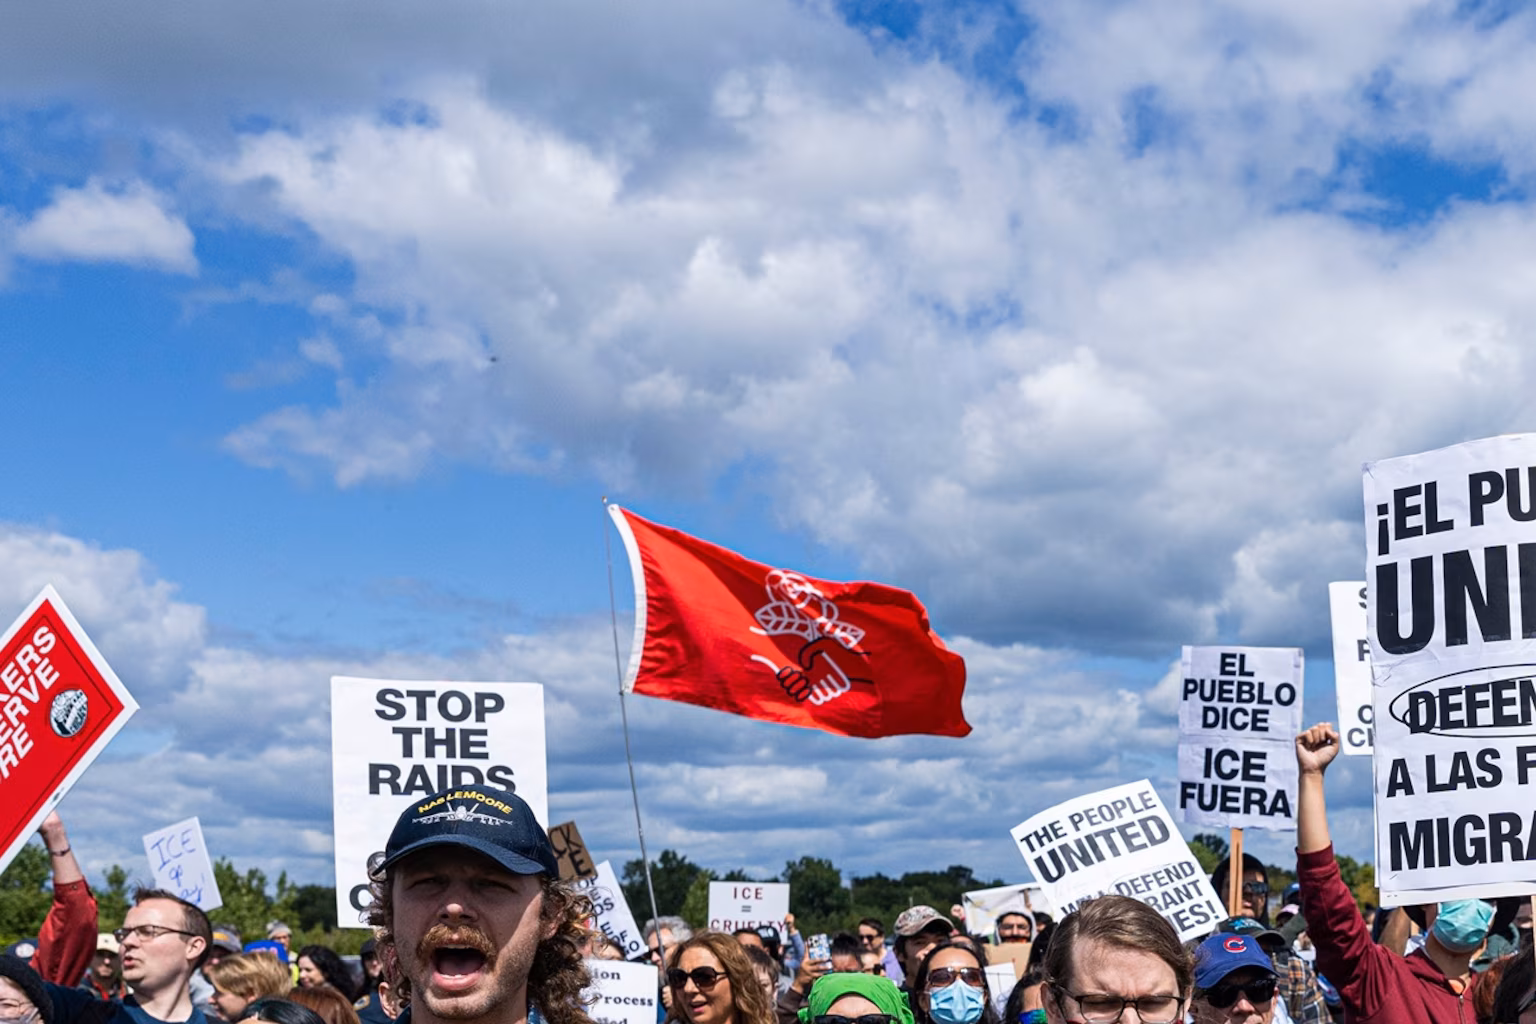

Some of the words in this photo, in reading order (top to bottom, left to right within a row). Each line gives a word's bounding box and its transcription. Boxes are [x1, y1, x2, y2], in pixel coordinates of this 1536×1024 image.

[1376, 481, 1454, 556] ¡EL
[1219, 652, 1255, 677] EL
[375, 688, 505, 723] STOP
[1183, 678, 1296, 706] PUEBLO
[1202, 706, 1270, 732] DICE
[392, 726, 489, 760] THE
[368, 763, 516, 796] RAIDS
[1203, 748, 1267, 783] ICE
[1386, 757, 1415, 798] A
[1426, 747, 1503, 793] LAS
[418, 797, 445, 814] NAS
[447, 791, 513, 814] LEMOORE
[1180, 781, 1292, 818] FUERA
[1020, 820, 1067, 853] THE
[1068, 790, 1156, 832] PEOPLE
[151, 829, 196, 871] ICE
[1034, 815, 1170, 884] UNITED
[733, 887, 763, 900] ICE
[1115, 861, 1195, 897] DEFEND
